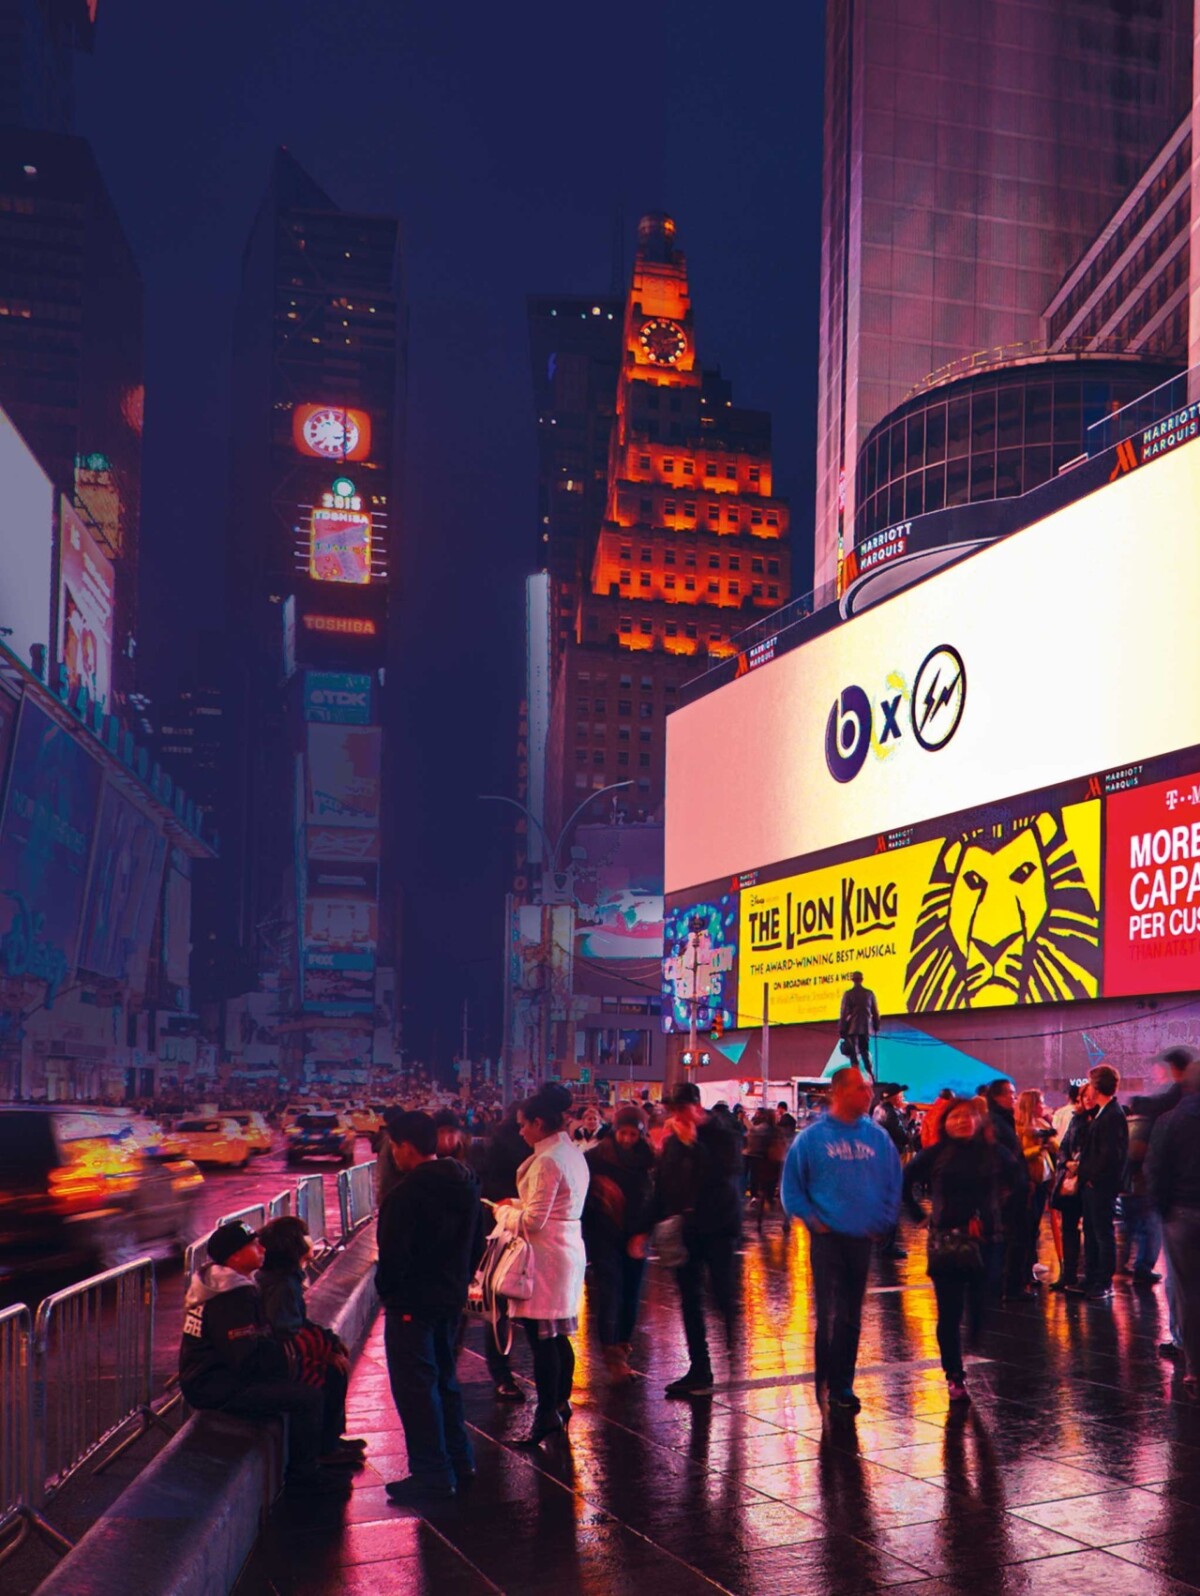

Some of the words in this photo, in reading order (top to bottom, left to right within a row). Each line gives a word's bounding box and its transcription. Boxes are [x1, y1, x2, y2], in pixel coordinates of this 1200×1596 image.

[1143, 421, 1197, 460] MARQUIS
[315, 512, 370, 525] TOSHIBA
[860, 522, 913, 555] MARRIOTT
[860, 540, 905, 570] MARQUIS
[303, 615, 375, 635] TOSHIBA
[750, 636, 778, 657] MARRIOTT
[323, 690, 367, 707] TDK
[1105, 765, 1143, 782] MARRIOTT
[1105, 776, 1139, 793] MARQUIS
[749, 906, 781, 945] THE
[786, 892, 834, 950] LION
[841, 877, 898, 941] KING
[1129, 912, 1165, 940] PER
[750, 963, 765, 976] THE
[765, 953, 834, 974] AWARD-WINNING
[836, 948, 855, 963] BEST
[856, 942, 897, 960] MUSICAL
[841, 972, 854, 982] WEE
